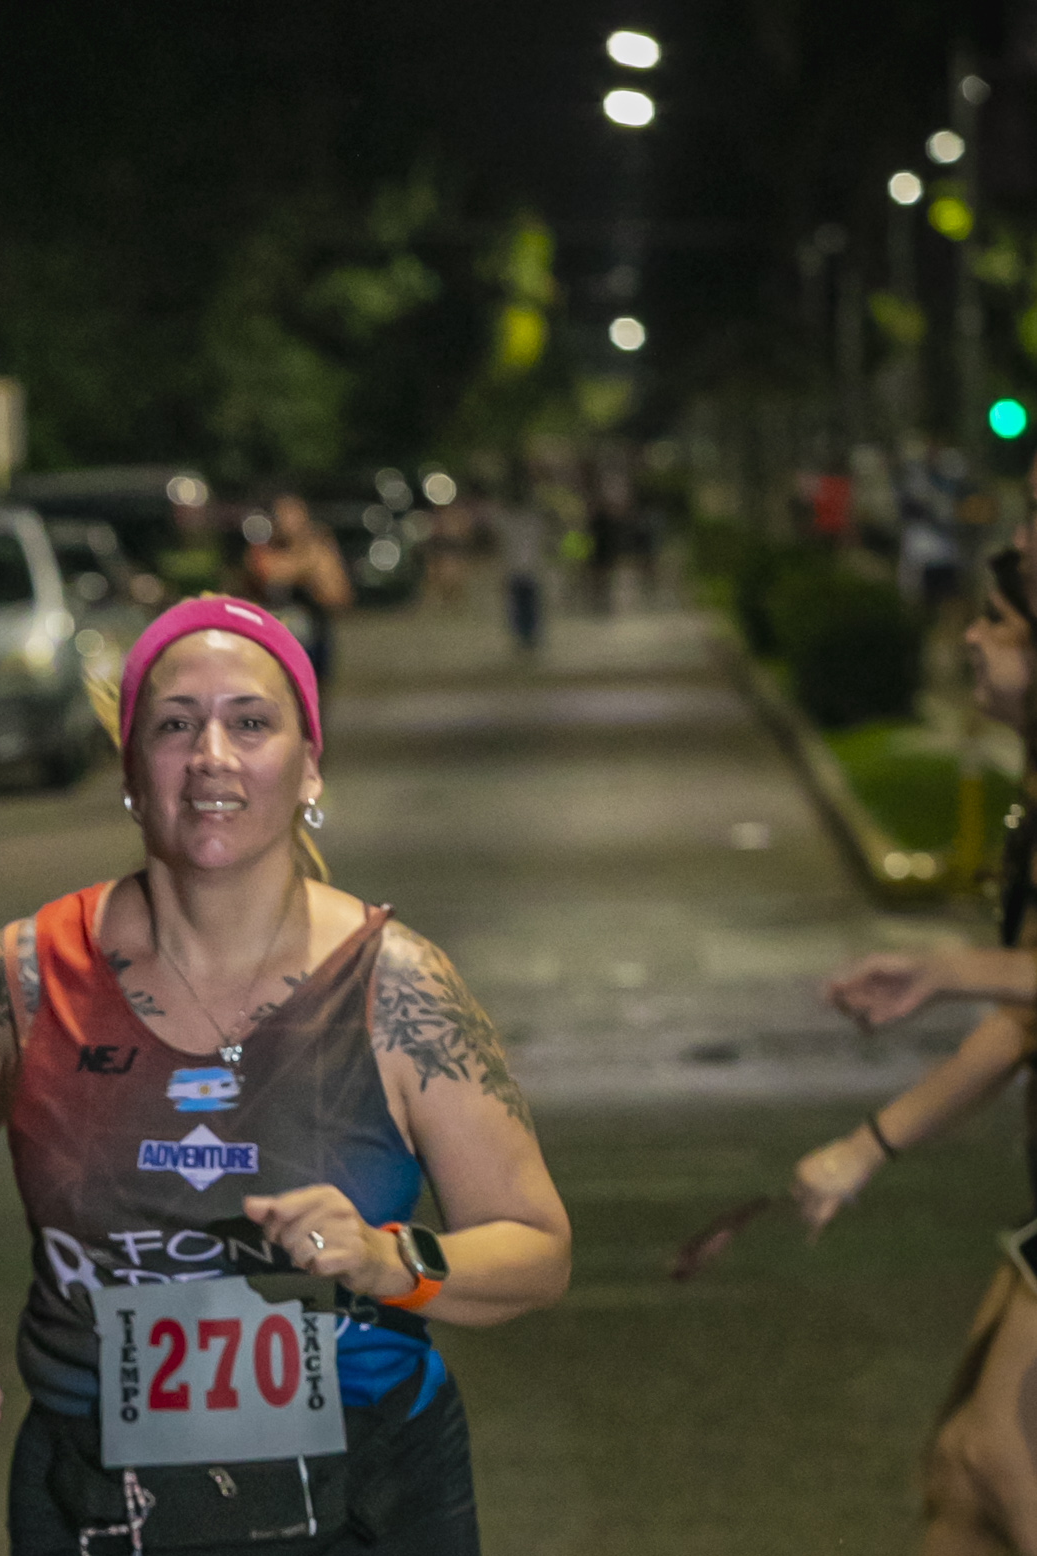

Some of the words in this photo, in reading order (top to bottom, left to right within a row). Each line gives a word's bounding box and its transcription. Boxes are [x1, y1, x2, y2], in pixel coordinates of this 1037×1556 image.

[142, 1144, 253, 1169] ADVENTURE
[107, 1229, 275, 1266] FON
[116, 1309, 141, 1424] TIEMPO
[146, 1313, 301, 1412] 270
[302, 1314, 326, 1411] XACTO
